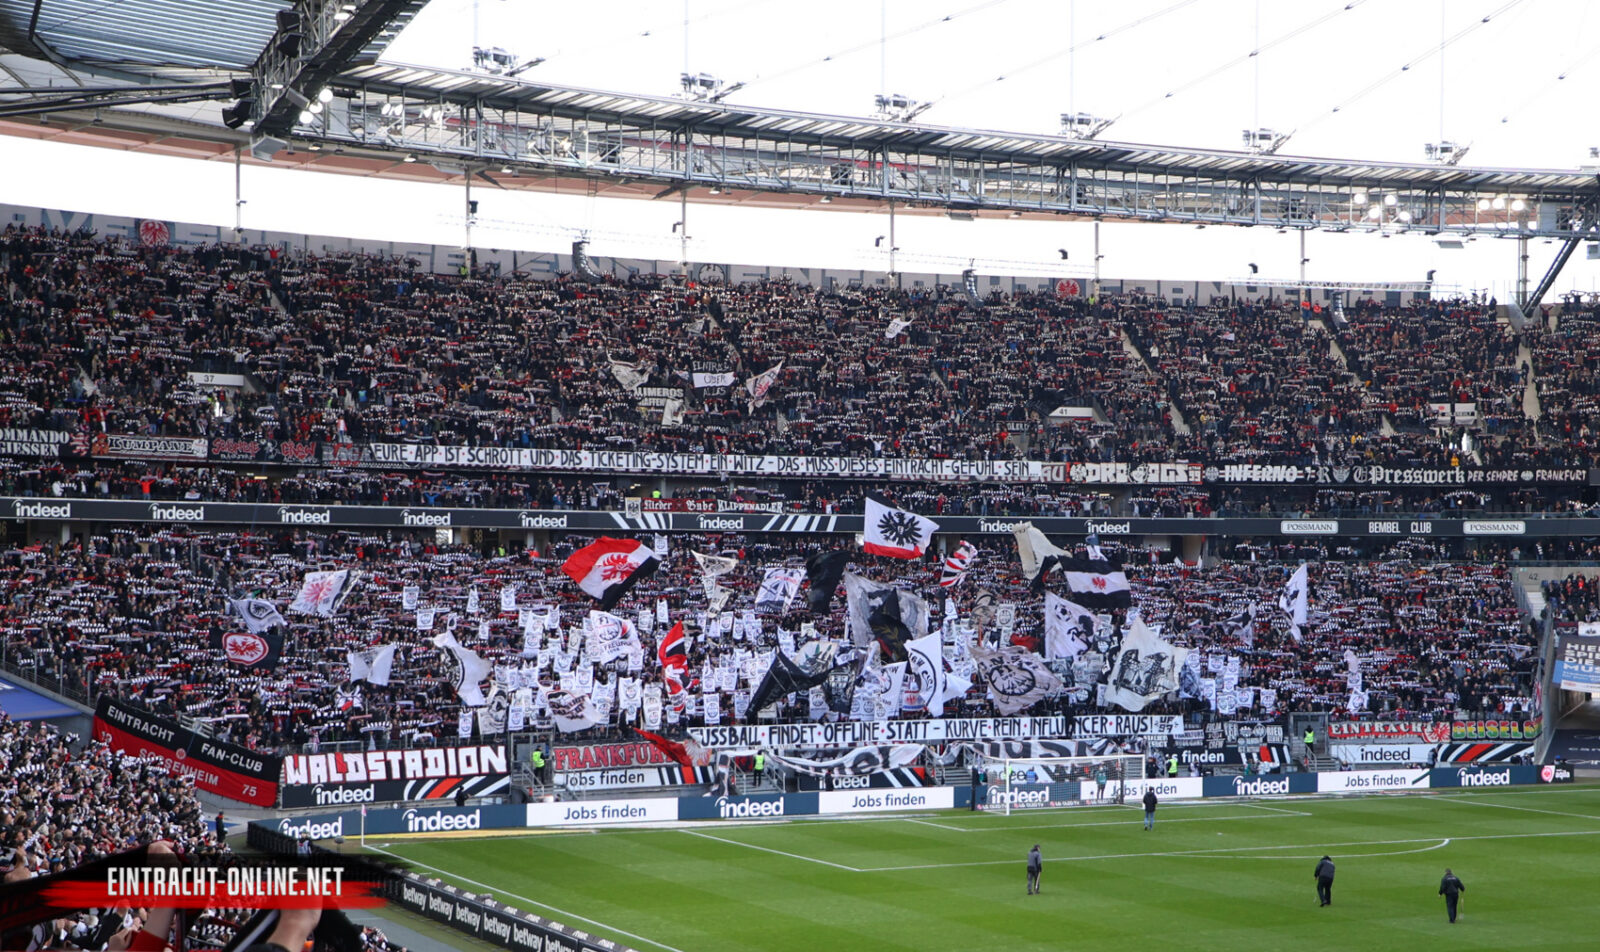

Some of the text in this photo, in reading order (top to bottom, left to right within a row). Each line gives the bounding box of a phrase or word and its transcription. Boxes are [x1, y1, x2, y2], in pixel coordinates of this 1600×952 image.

[0, 441, 59, 456] GIESSEN
[108, 437, 193, 453] KUMPANE
[374, 444, 408, 461] EURE
[415, 445, 439, 461] APP
[445, 446, 460, 462] IST
[467, 448, 523, 465] SCHROTT
[530, 449, 555, 465] UND
[561, 450, 582, 466] DAS
[588, 450, 704, 469] TICKETING-SYSTEM
[710, 454, 728, 470] EIN
[734, 454, 764, 471] WITZ
[778, 456, 800, 472] DAS
[806, 457, 835, 472] MUSS
[839, 458, 880, 473] DIESES
[1224, 464, 1298, 482] INFERNO
[1467, 469, 1586, 482] PER SEMPRE FRANKFURT
[16, 502, 70, 518] indeed
[152, 503, 204, 521] indeed
[717, 499, 783, 514] KLIPPENADLER
[281, 508, 330, 524] indeed
[403, 511, 450, 526] indeed
[522, 514, 567, 528] indeed
[700, 515, 744, 530] indeed
[980, 519, 1022, 533] indee
[1087, 521, 1130, 534] indeed
[1286, 523, 1333, 531] POSSMANN
[1368, 521, 1432, 534] BEMBEL CLUB
[1469, 523, 1520, 531] POSSMANN
[1567, 642, 1600, 652] HIE
[107, 705, 175, 742] EINTRACHT
[768, 725, 817, 744] FINDET
[824, 722, 880, 742] OFFLINE
[887, 720, 930, 739] STATT
[945, 719, 988, 738] KURVE
[1029, 716, 1109, 736] INFLUNCER
[1115, 715, 1153, 733] RAUS!
[1332, 720, 1434, 736] EINTRACHT
[200, 742, 263, 773] FAN-CLUB
[1181, 750, 1225, 763] finden
[1360, 745, 1411, 760] indeed
[284, 745, 508, 785] WALDSTADION
[564, 771, 645, 787] Jobs finden
[1345, 774, 1406, 787] Jobs finden
[1461, 768, 1510, 786] indeed
[242, 783, 257, 797] 75
[1236, 776, 1289, 795] indeed
[316, 784, 375, 805] indeed
[852, 792, 926, 808] Jobs finden
[990, 785, 1050, 804] indeed
[564, 804, 647, 821] Jobs finden
[720, 796, 784, 817] indeed
[283, 816, 343, 840] indeed
[408, 808, 480, 833] indeed
[403, 883, 427, 911] betway
[429, 891, 454, 920] betway
[455, 902, 481, 932] betway
[483, 912, 511, 943] betway
[513, 923, 543, 952] betway
